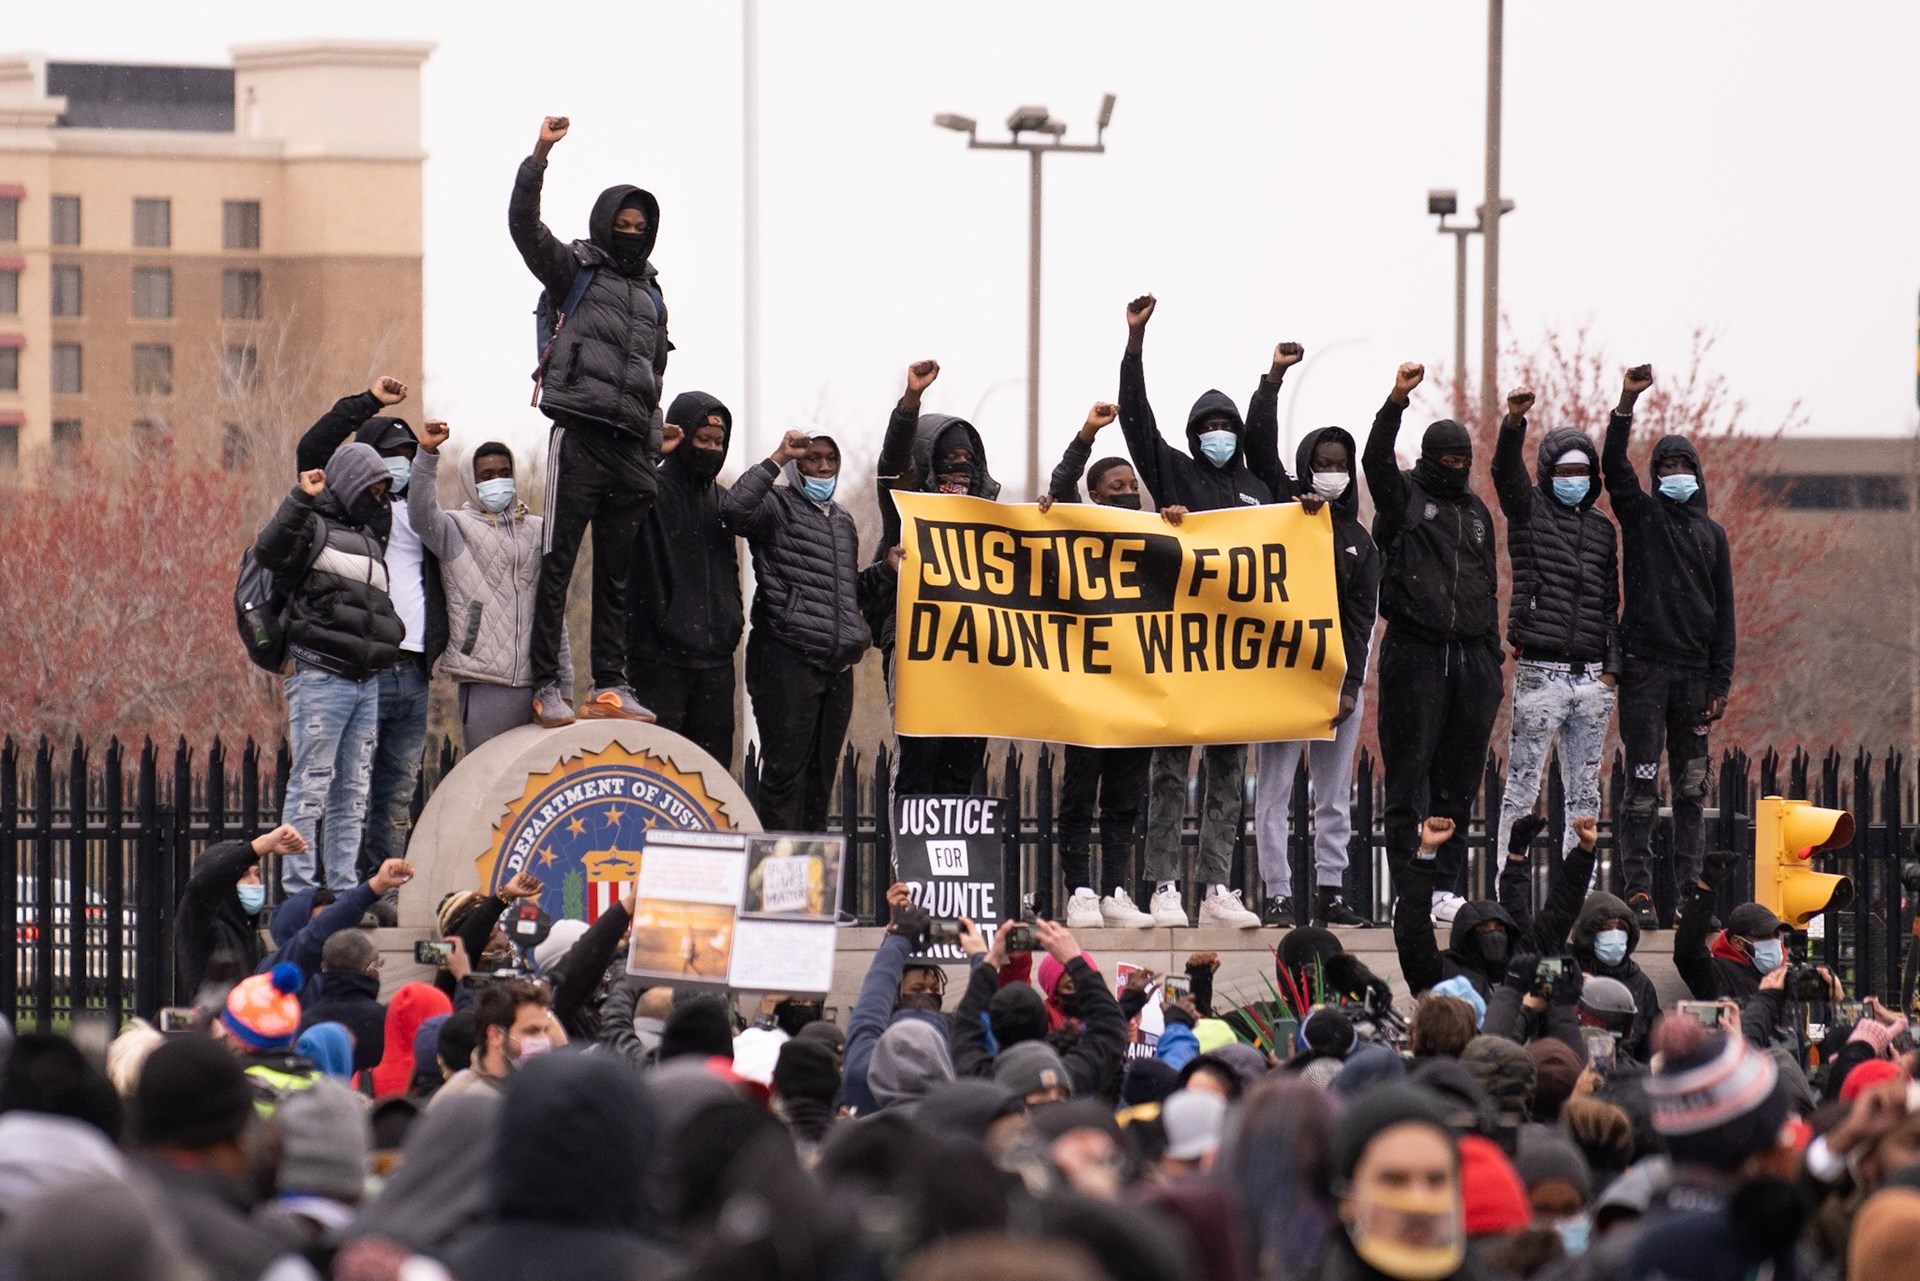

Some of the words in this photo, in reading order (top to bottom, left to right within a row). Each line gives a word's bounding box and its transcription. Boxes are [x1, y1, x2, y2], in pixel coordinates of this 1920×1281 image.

[922, 527, 1146, 600] JUSTICE
[1187, 543, 1287, 603] FOR
[907, 603, 1113, 674] DAUNTE
[1136, 614, 1333, 674] WRIGHT
[507, 778, 624, 872] DEPARTMENT
[632, 782, 659, 802] OF
[658, 793, 702, 831] JUST
[899, 799, 998, 835] JUSTICE
[935, 848, 962, 868] FOR
